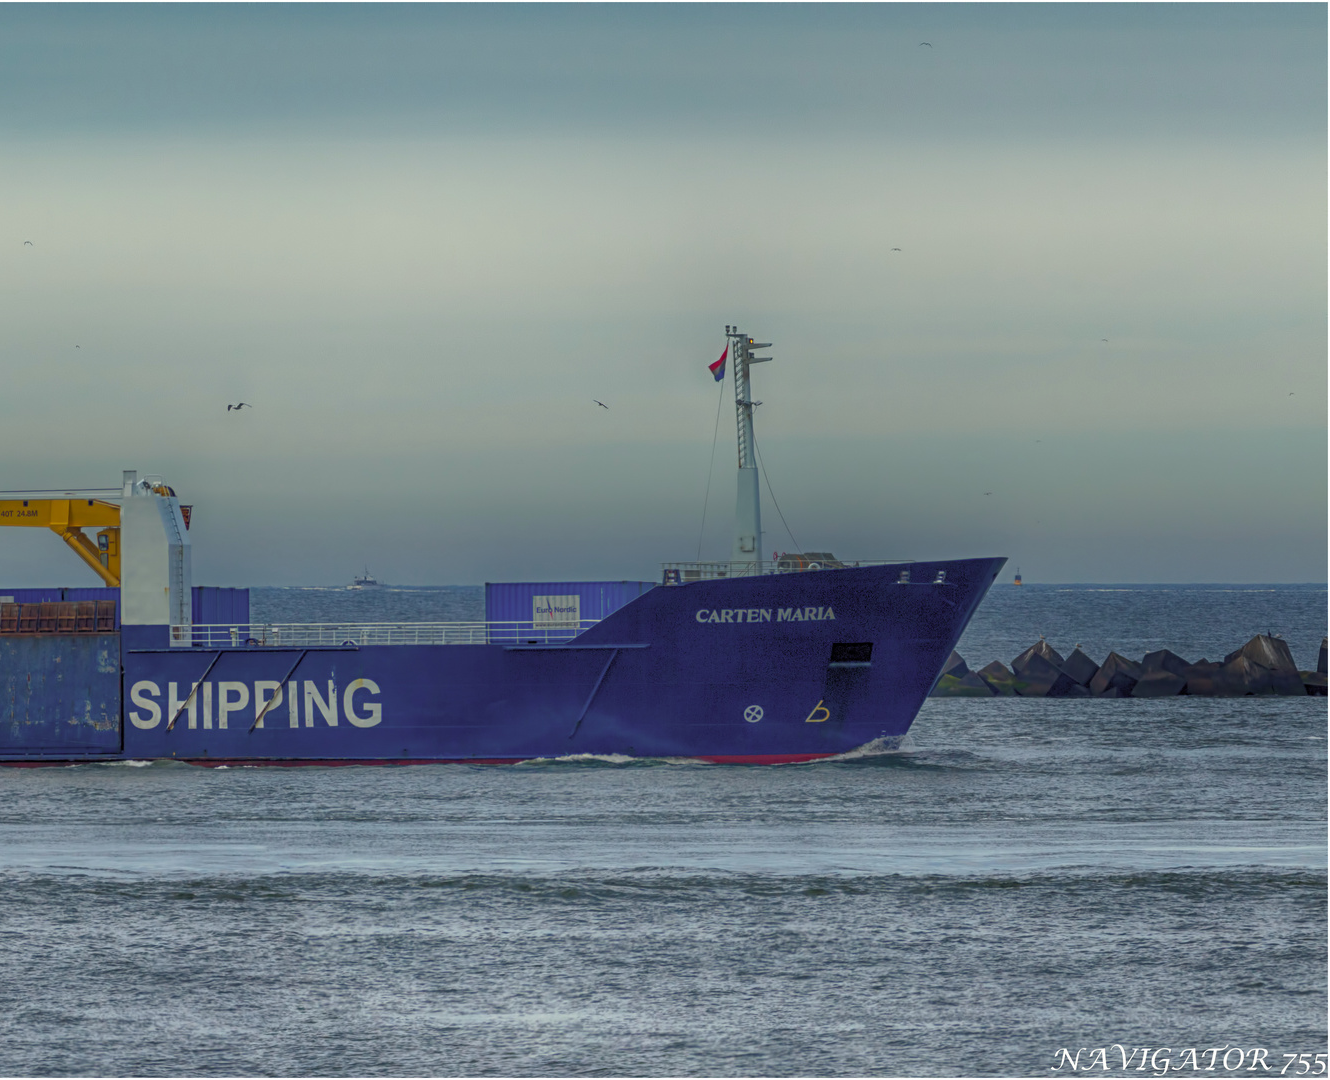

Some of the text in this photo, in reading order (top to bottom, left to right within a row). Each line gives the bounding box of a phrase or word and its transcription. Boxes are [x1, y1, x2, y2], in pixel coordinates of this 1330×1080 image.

[696, 606, 836, 623] CARTEN MARIA
[128, 678, 383, 730] SHIPPING
